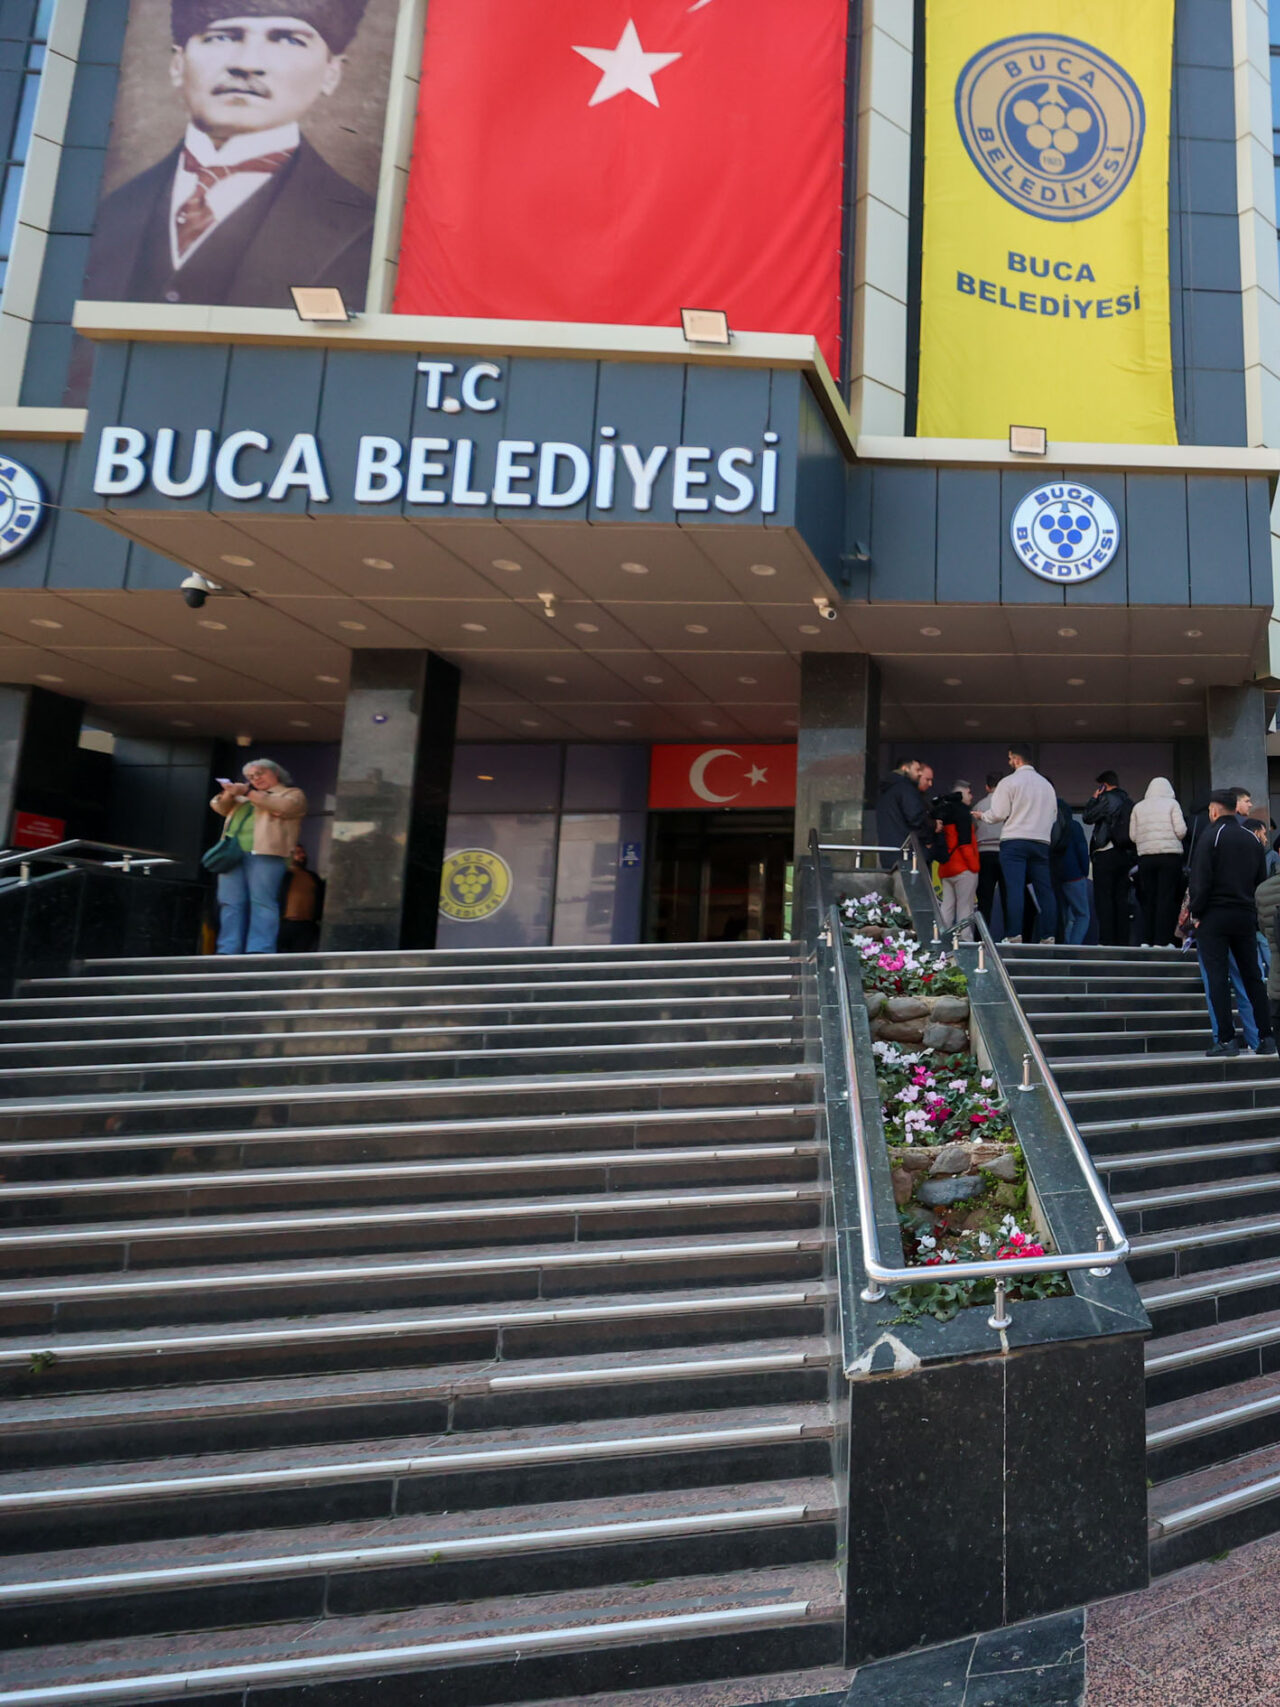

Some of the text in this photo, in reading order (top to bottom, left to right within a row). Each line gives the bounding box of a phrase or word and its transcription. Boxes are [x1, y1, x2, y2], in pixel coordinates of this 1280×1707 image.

[1004, 54, 1096, 89] BUCA
[977, 126, 1125, 204] BELEDİYESİ
[1007, 250, 1096, 283] BUCA
[956, 270, 1141, 319] BELEDİYESİ
[417, 361, 500, 413] T.C
[93, 426, 779, 513] BUCA BELEDİYESİ
[1034, 486, 1095, 508] BUCA
